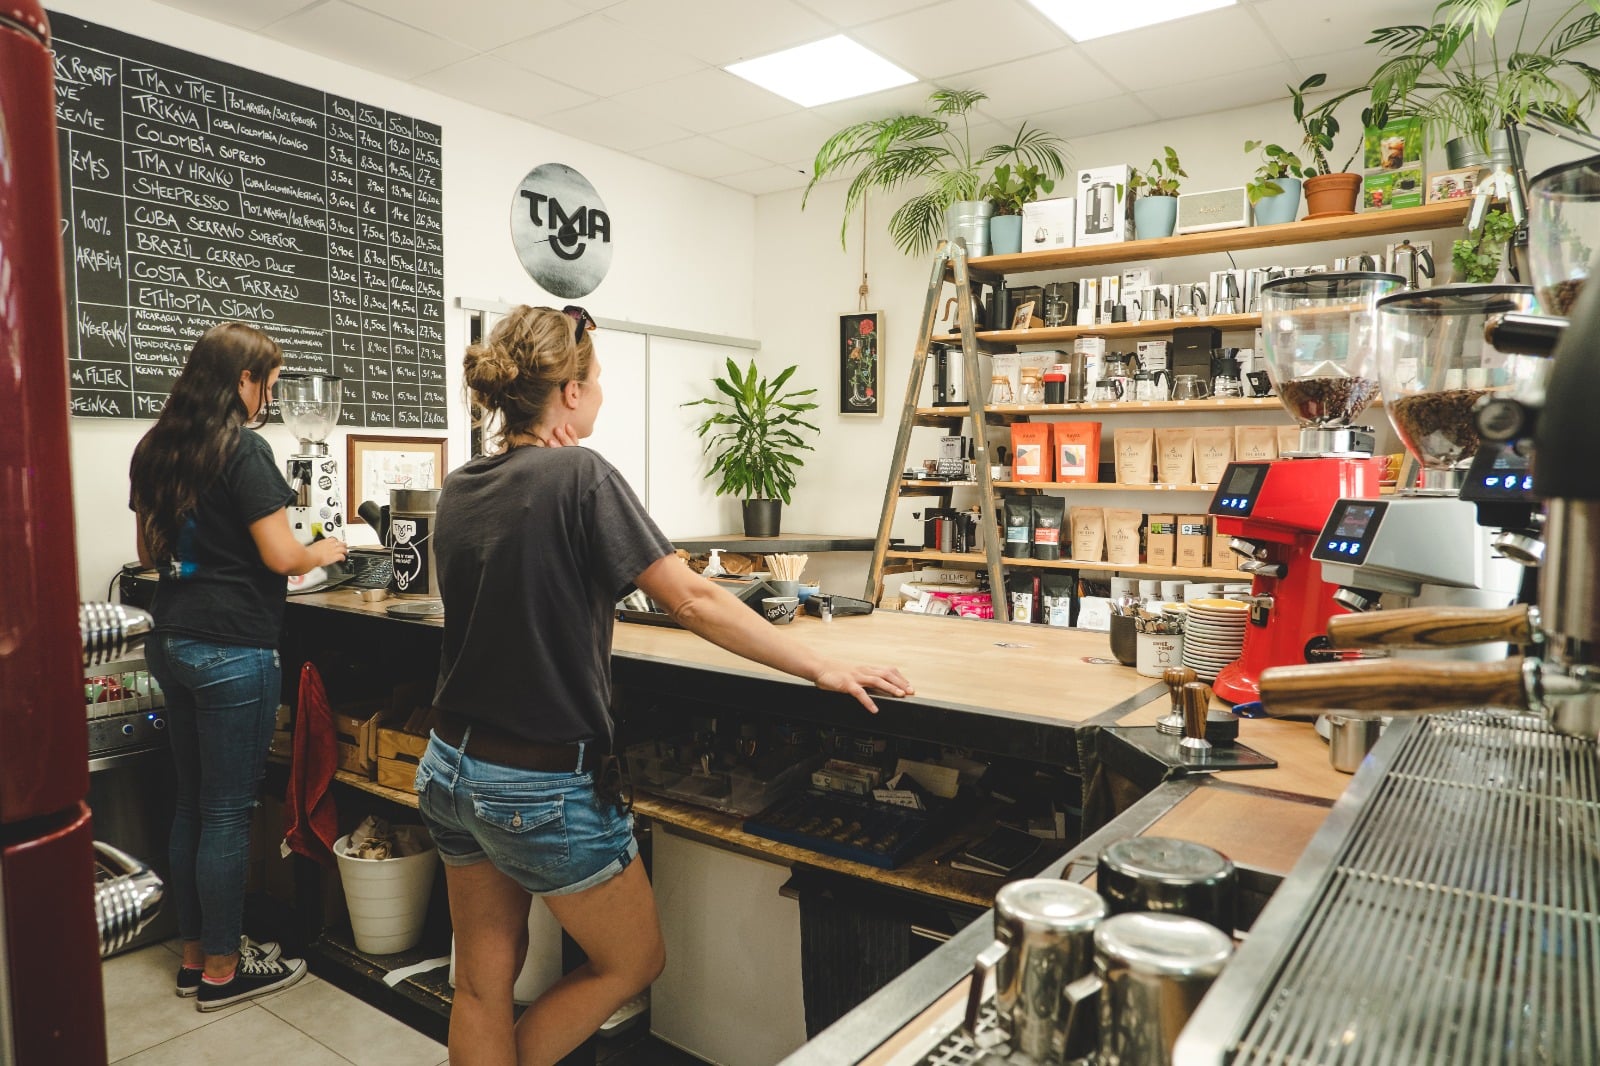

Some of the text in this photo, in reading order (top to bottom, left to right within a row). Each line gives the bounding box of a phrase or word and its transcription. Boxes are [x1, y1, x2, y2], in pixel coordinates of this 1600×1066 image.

[72, 57, 117, 86] ROASTY
[131, 68, 170, 94] TMA
[183, 80, 217, 104] TME
[329, 123, 354, 141] 3,30€
[358, 130, 383, 150] 7,40€
[72, 150, 110, 180] ZMES
[136, 123, 214, 157] COLOMBIA
[219, 145, 266, 166] SUPREMO
[330, 170, 354, 186] 3,50€
[132, 150, 170, 175] TMA
[189, 162, 234, 187] HRNKU
[329, 192, 356, 209] 3,60€
[363, 201, 377, 214] 8€
[391, 206, 410, 222] 14€
[417, 168, 436, 186] 27€
[80, 209, 111, 236] 100%
[132, 178, 230, 211] SHEEPRESSO
[329, 218, 355, 235] 3,40€
[361, 223, 386, 241] 7,50€
[520, 189, 611, 243] TMA
[134, 206, 442, 276] CUBA SERRANO SUPERIOR 3,90€ 8,70€ 15,40€ 28,90€
[76, 246, 122, 279] ARABICA
[136, 232, 201, 259] BRAZIL
[206, 247, 261, 268] CERRADO
[265, 257, 296, 274] DULCE
[330, 266, 357, 282] 3,20€
[363, 271, 388, 288] 7,20€
[391, 276, 415, 293] 12,60€
[134, 261, 191, 287] COSTA
[195, 268, 231, 291] RICA
[234, 275, 300, 301] TARRAZU
[332, 289, 358, 306] 3,70€
[363, 294, 388, 311] 8,30€
[423, 303, 440, 317] 27€
[138, 287, 217, 315] ETHIOPIA
[219, 299, 275, 320] SIDAMO
[363, 318, 387, 332] 8,50€
[134, 337, 181, 351] HONDURAS
[135, 309, 183, 325] NICARAGUA
[342, 338, 356, 352] 4€
[137, 322, 177, 336] COLOMBIA
[134, 352, 180, 365] COLOMBIA
[85, 366, 129, 388] FILTER
[135, 366, 164, 377] KENYA
[344, 386, 357, 398] 4€
[69, 395, 121, 415] OFEÍNKA
[137, 395, 170, 413] MEX
[342, 408, 356, 420] 4€
